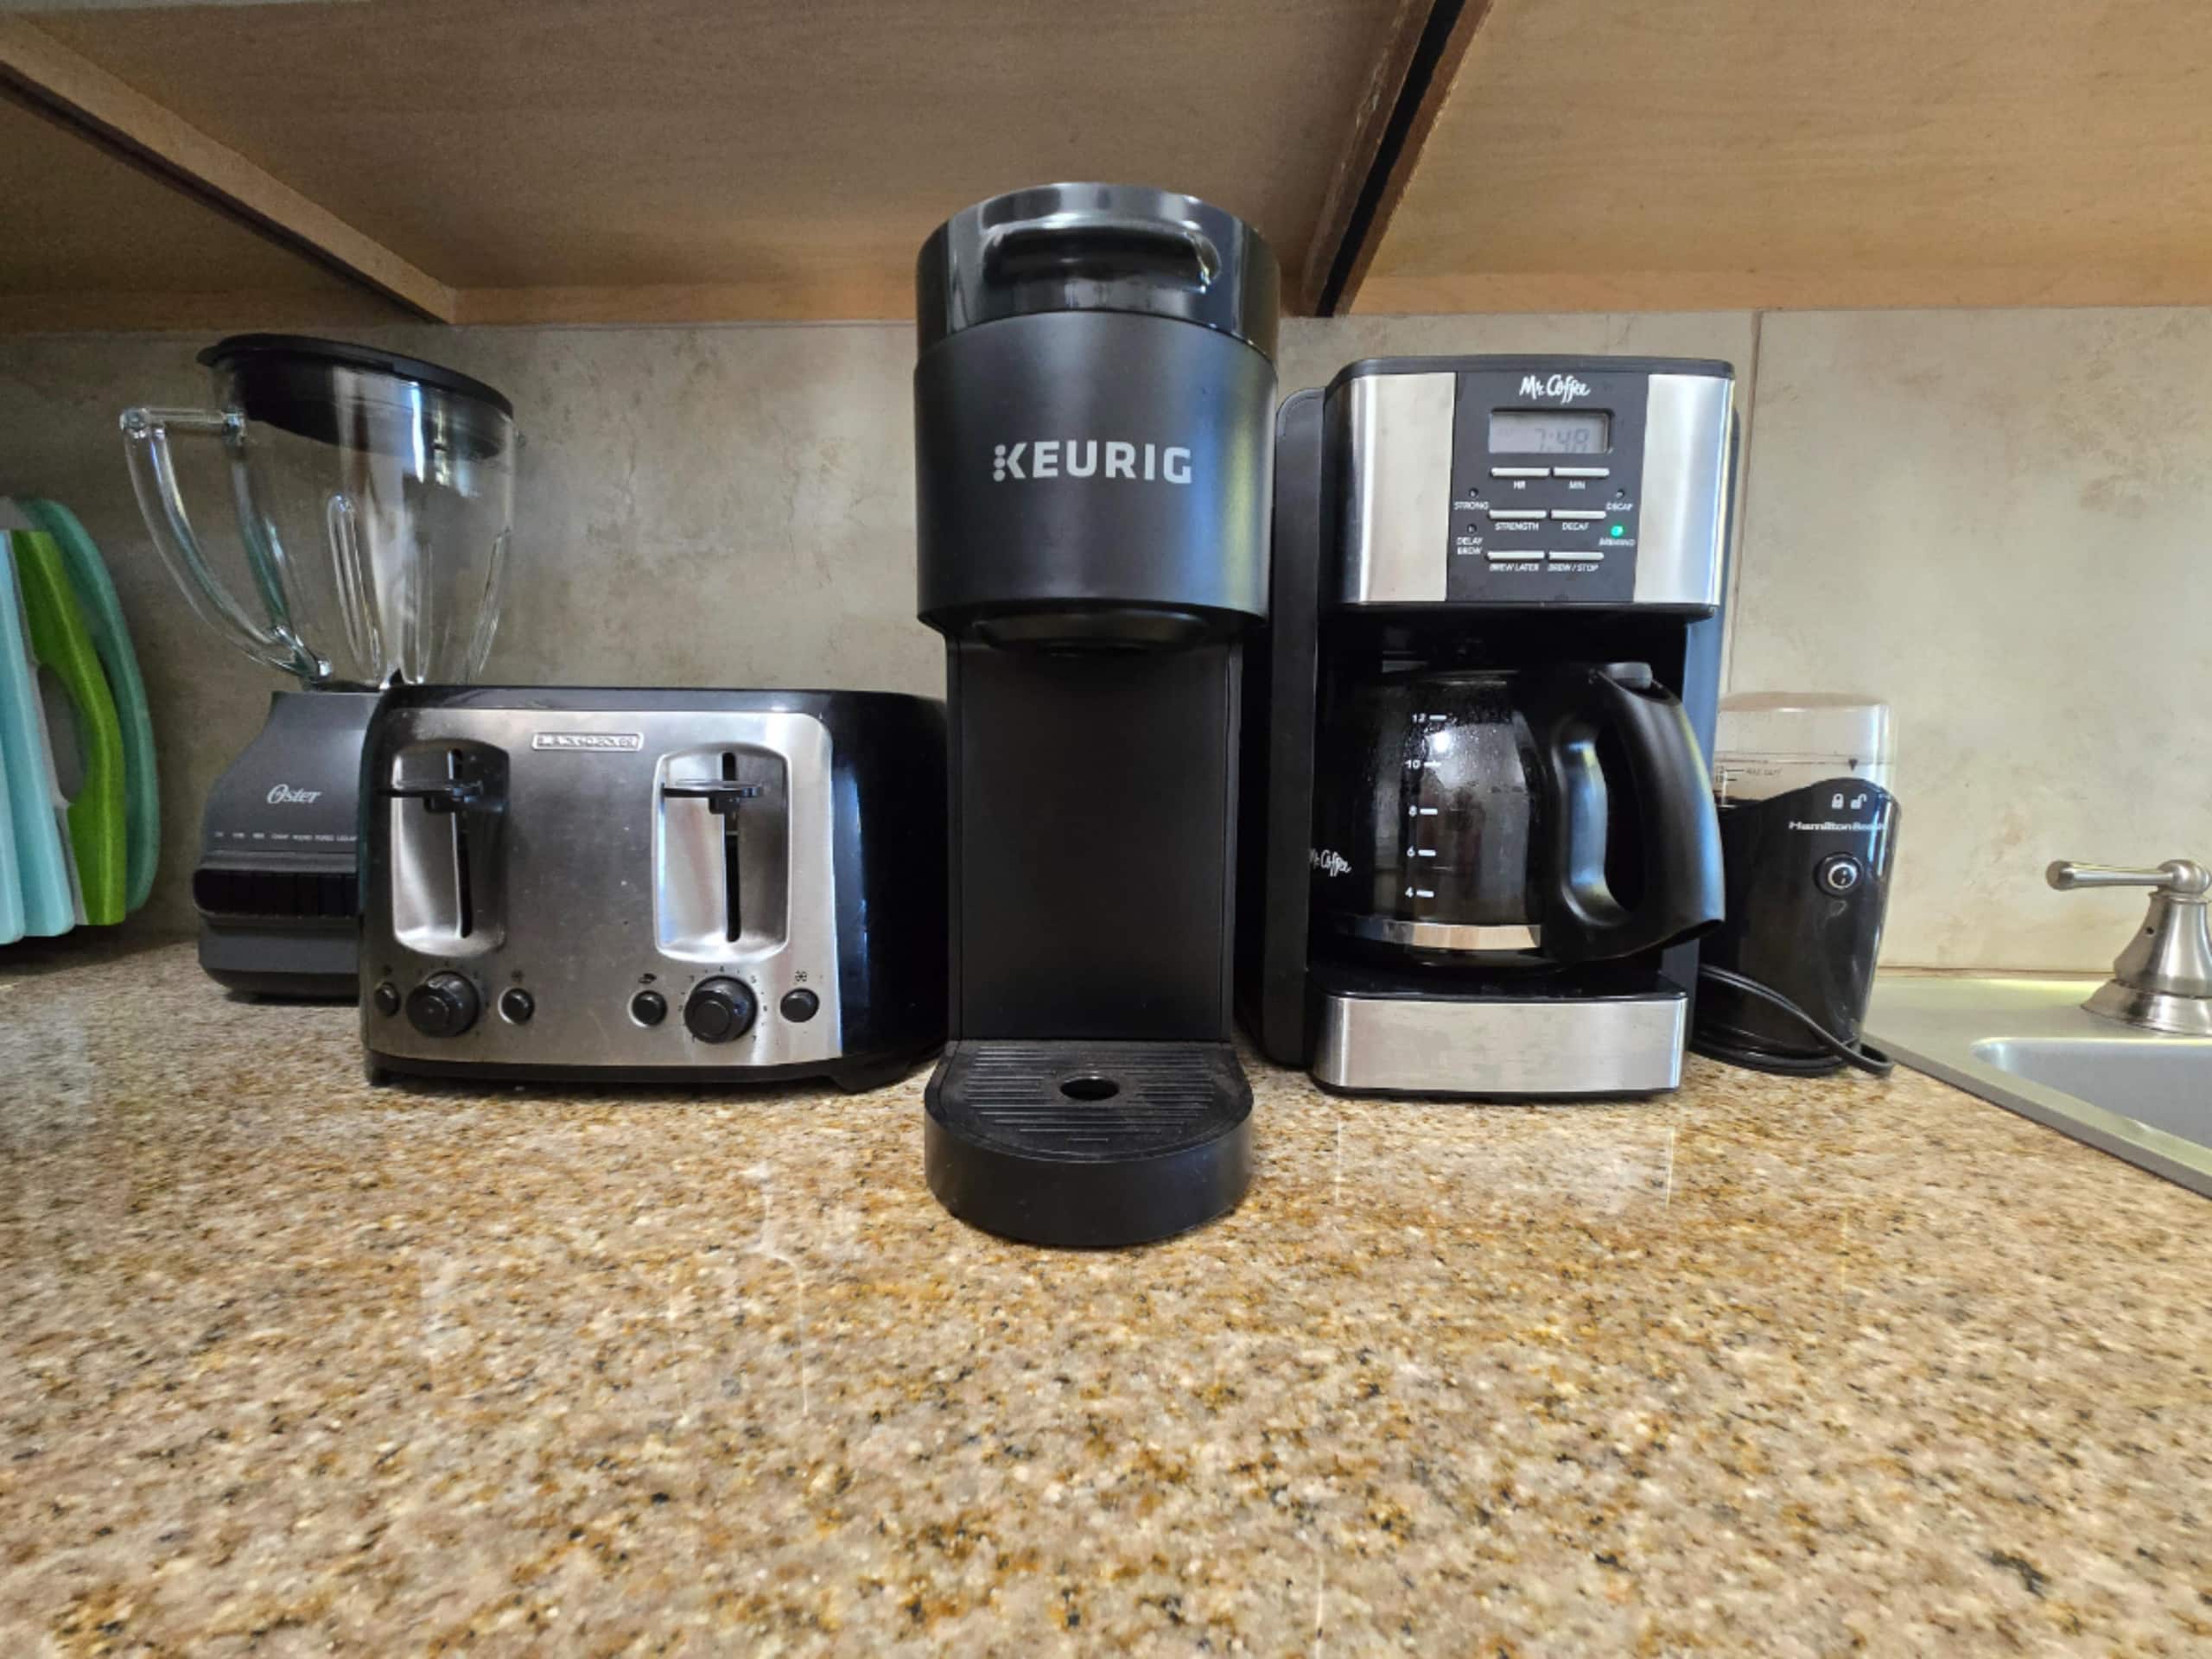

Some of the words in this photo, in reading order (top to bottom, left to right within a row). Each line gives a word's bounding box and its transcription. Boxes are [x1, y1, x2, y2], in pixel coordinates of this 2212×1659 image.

[1546, 373, 1591, 404] Coffee
[994, 440, 1192, 484] KEURIG
[1453, 501, 1490, 511] STRONG
[1495, 522, 1540, 531] STRENGTH
[1561, 522, 1590, 531] DECAF
[1456, 537, 1484, 545] DELAY
[1405, 760, 1421, 770] 10
[266, 784, 322, 804] Oster
[1408, 805, 1418, 817] 8
[1789, 821, 1852, 830] Hamilton
[1407, 846, 1416, 857] 6
[1320, 849, 1352, 877] Coffee
[1405, 887, 1414, 898] 4
